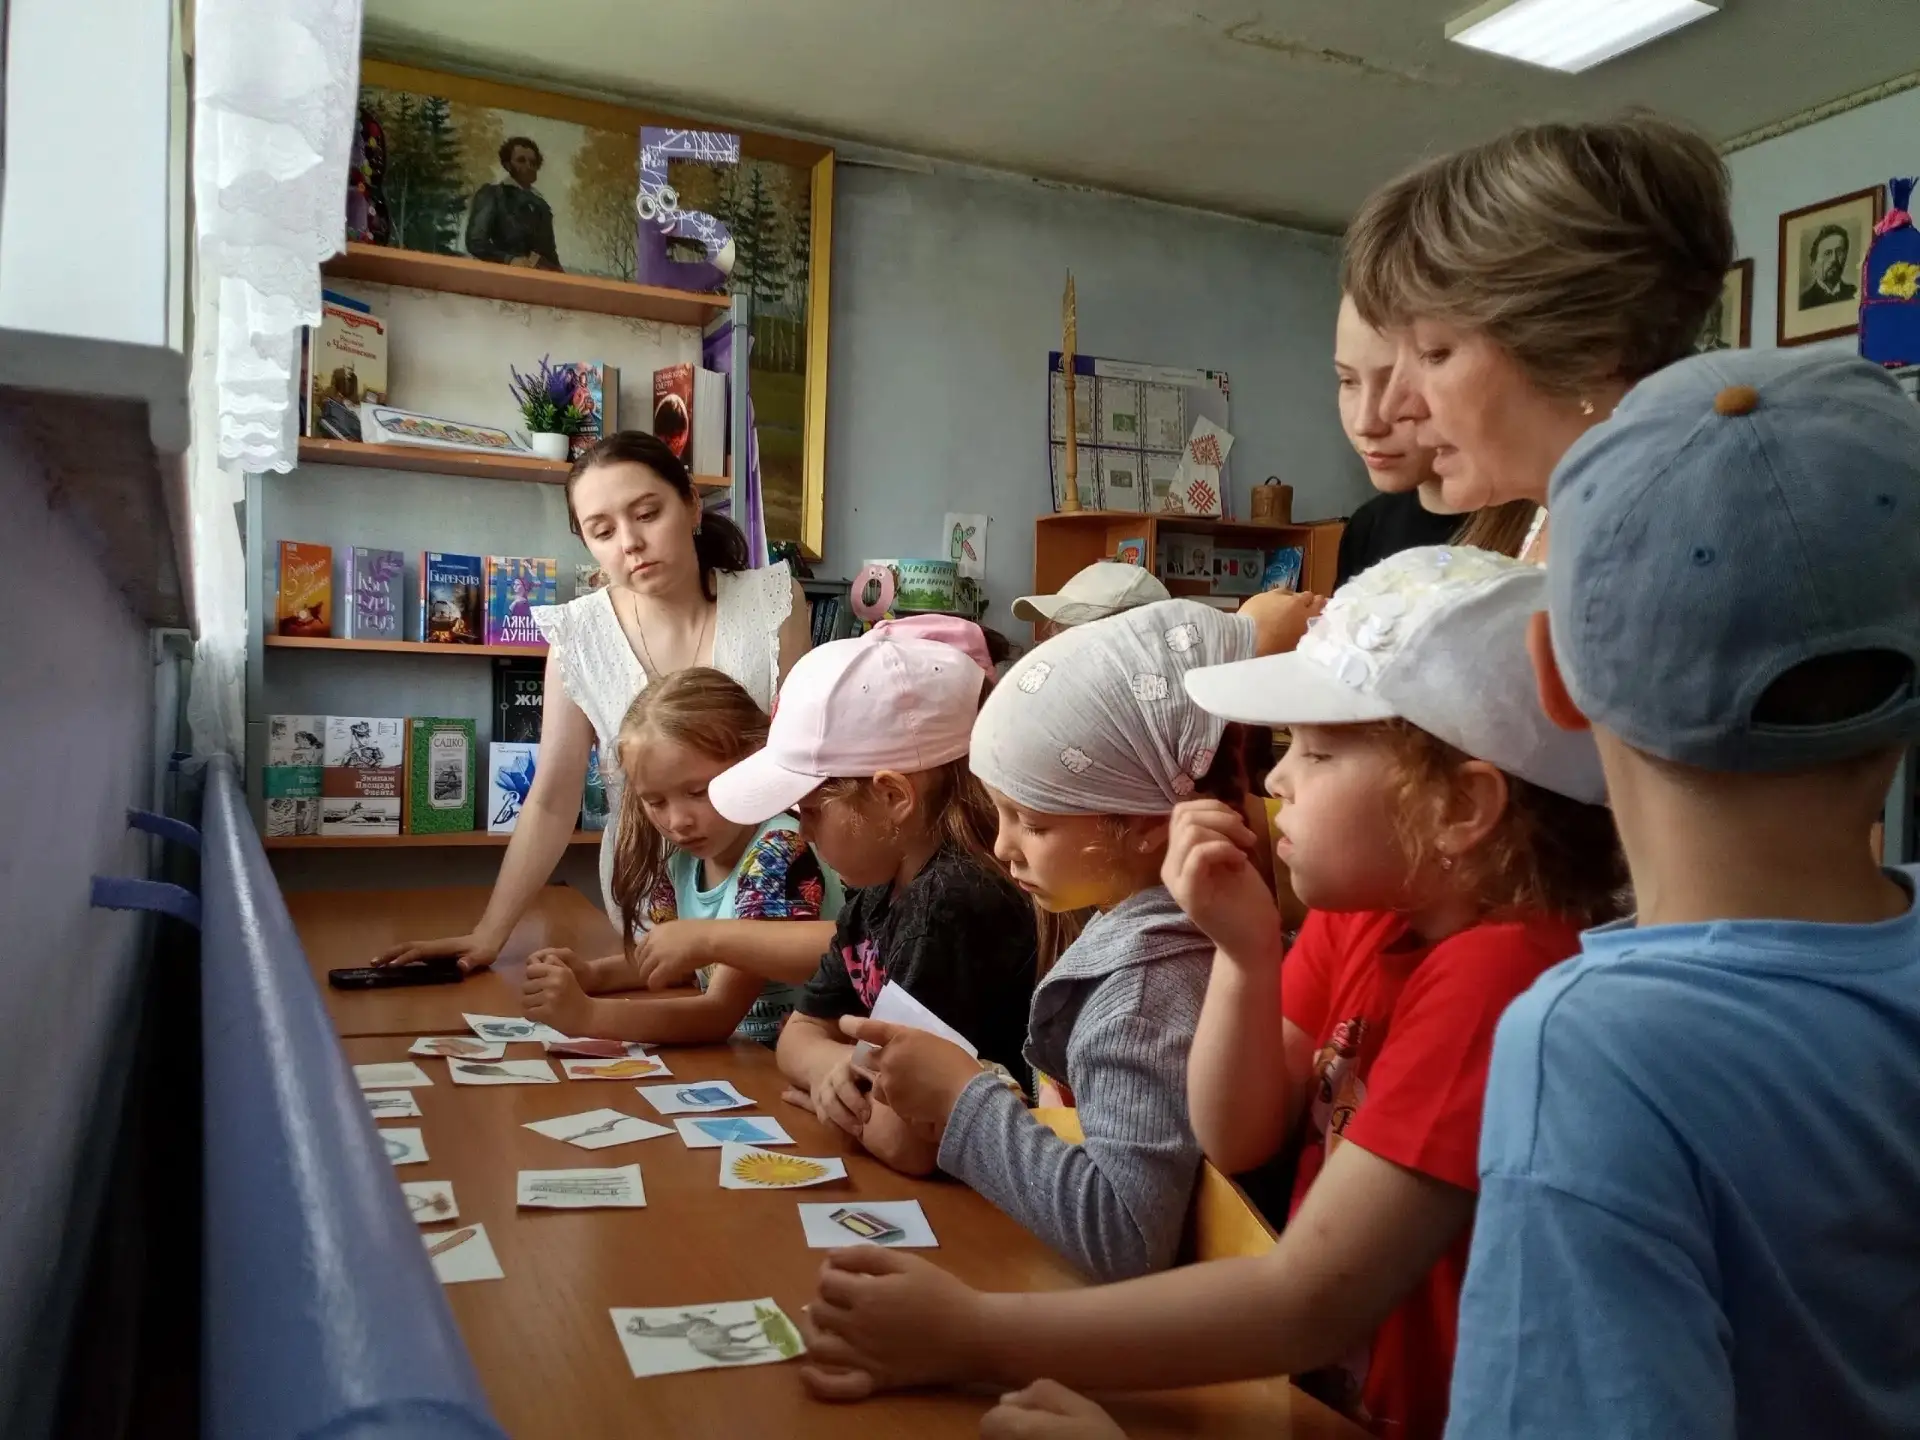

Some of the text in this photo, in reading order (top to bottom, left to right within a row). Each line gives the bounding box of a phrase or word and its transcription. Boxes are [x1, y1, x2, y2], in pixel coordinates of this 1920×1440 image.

[902, 564, 930, 574] ЧЕРЕЗ
[514, 695, 543, 707] ЖИ
[433, 738, 464, 748] САДКО
[355, 781, 396, 790] Площадь
